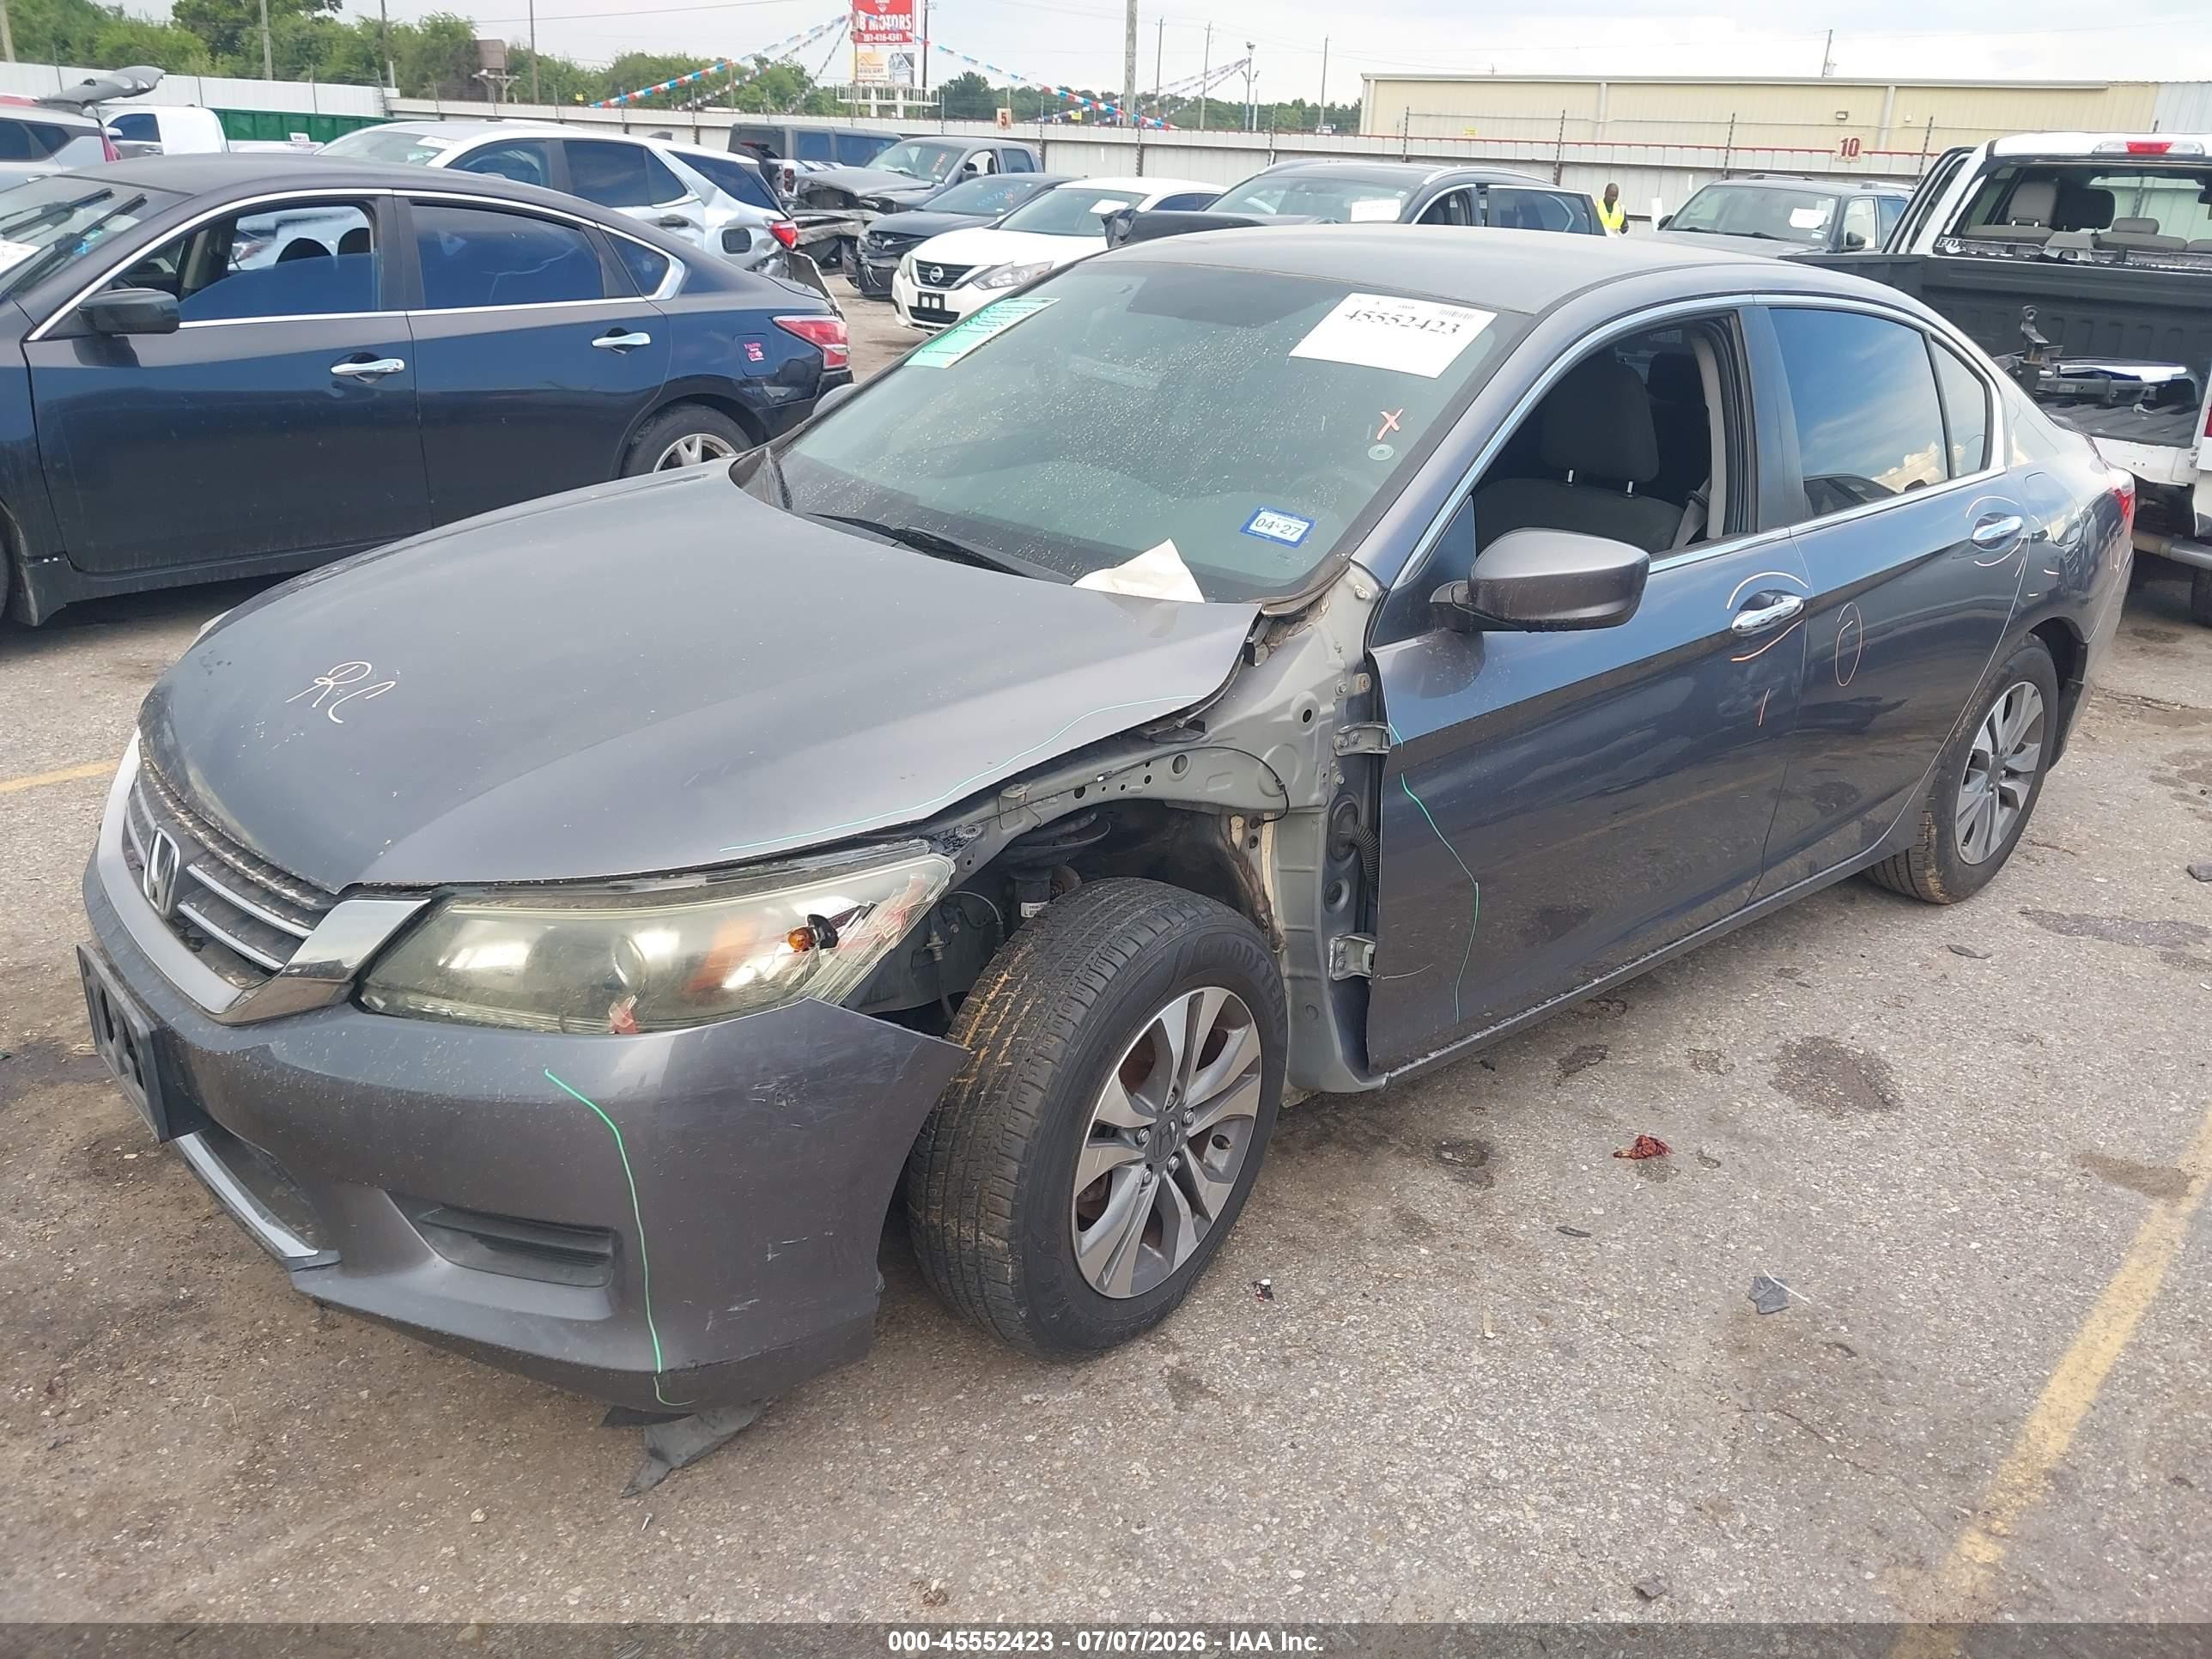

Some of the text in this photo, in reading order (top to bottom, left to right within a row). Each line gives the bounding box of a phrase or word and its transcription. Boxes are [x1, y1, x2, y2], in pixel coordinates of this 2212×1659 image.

[868, 14, 912, 30] MOTORS
[1001, 112, 1007, 126] 5
[1840, 137, 1861, 157] 10
[1344, 308, 1461, 335] 45552423
